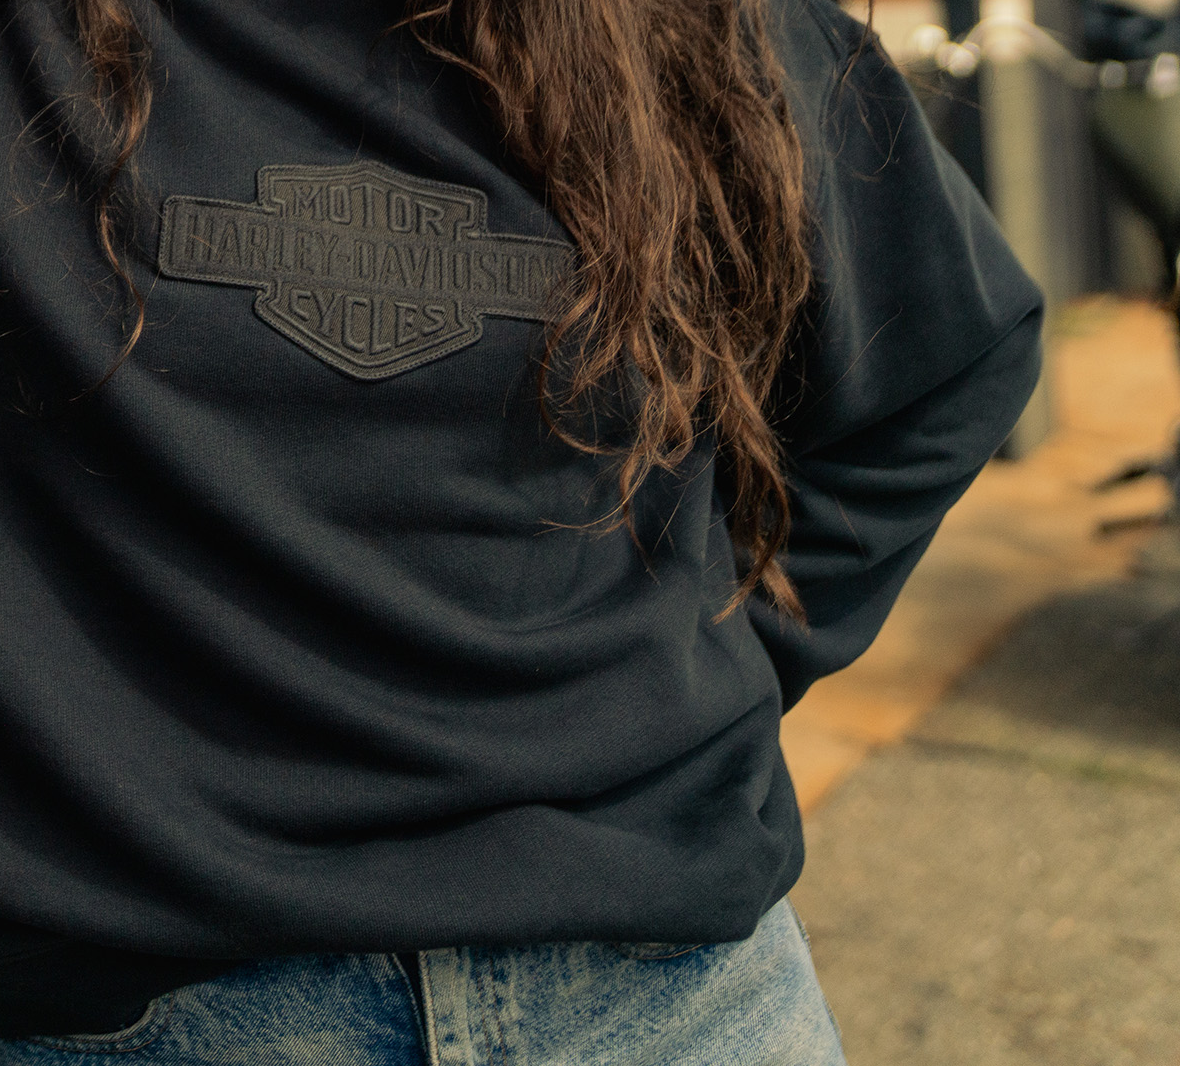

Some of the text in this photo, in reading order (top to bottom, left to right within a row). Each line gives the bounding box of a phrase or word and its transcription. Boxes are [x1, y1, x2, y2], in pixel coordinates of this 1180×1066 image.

[292, 183, 445, 234] MOTOR
[184, 211, 572, 301] HARLEY-DAVIDSON
[288, 290, 448, 355] CYCLES
